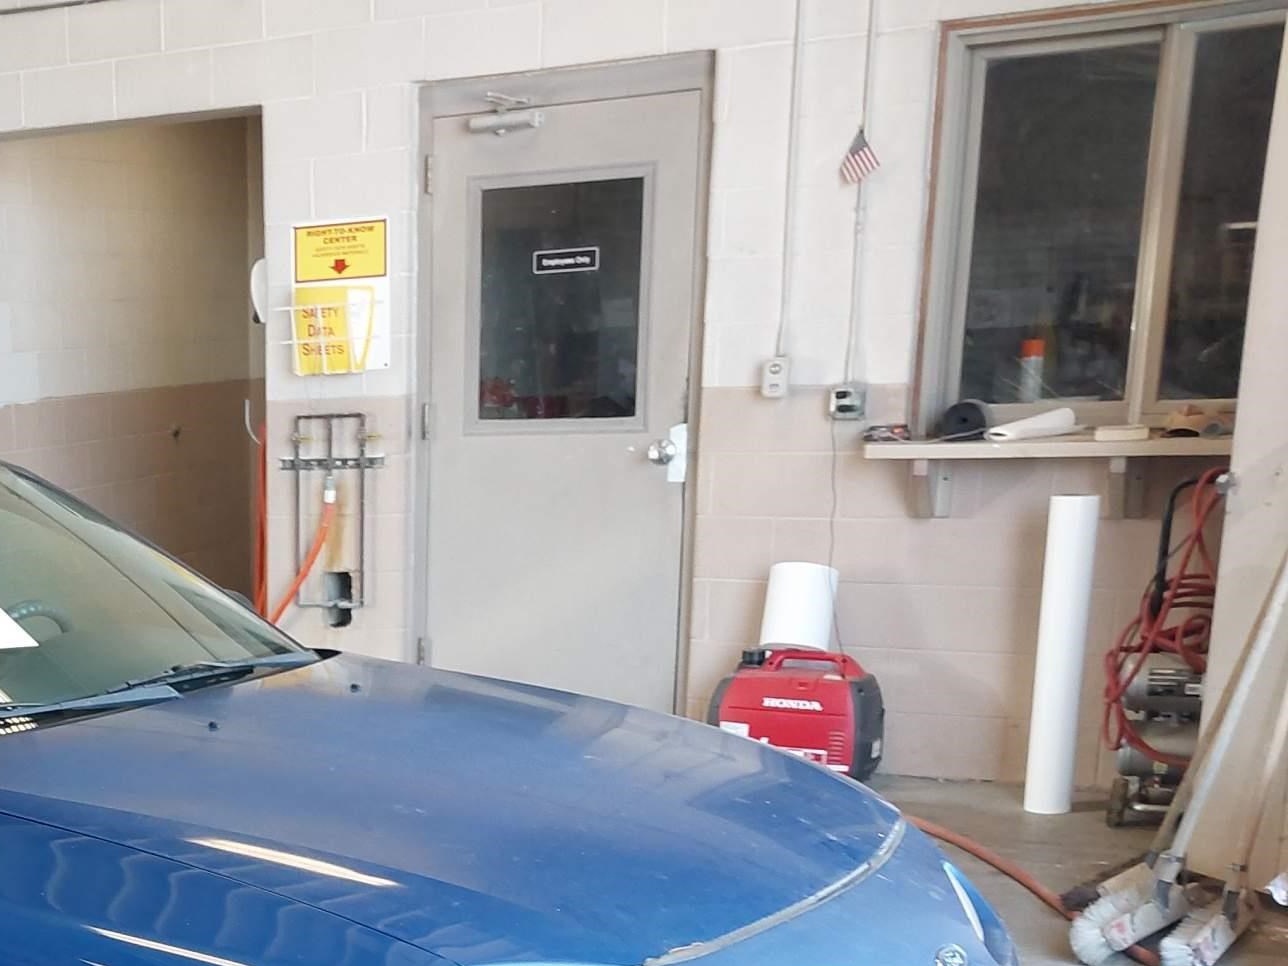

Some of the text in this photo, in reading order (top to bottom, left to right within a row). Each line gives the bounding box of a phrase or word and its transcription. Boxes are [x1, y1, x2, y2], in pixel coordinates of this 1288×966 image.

[323, 235, 358, 245] CENTER
[302, 306, 339, 319] SAETY
[762, 697, 824, 712] HONDA
